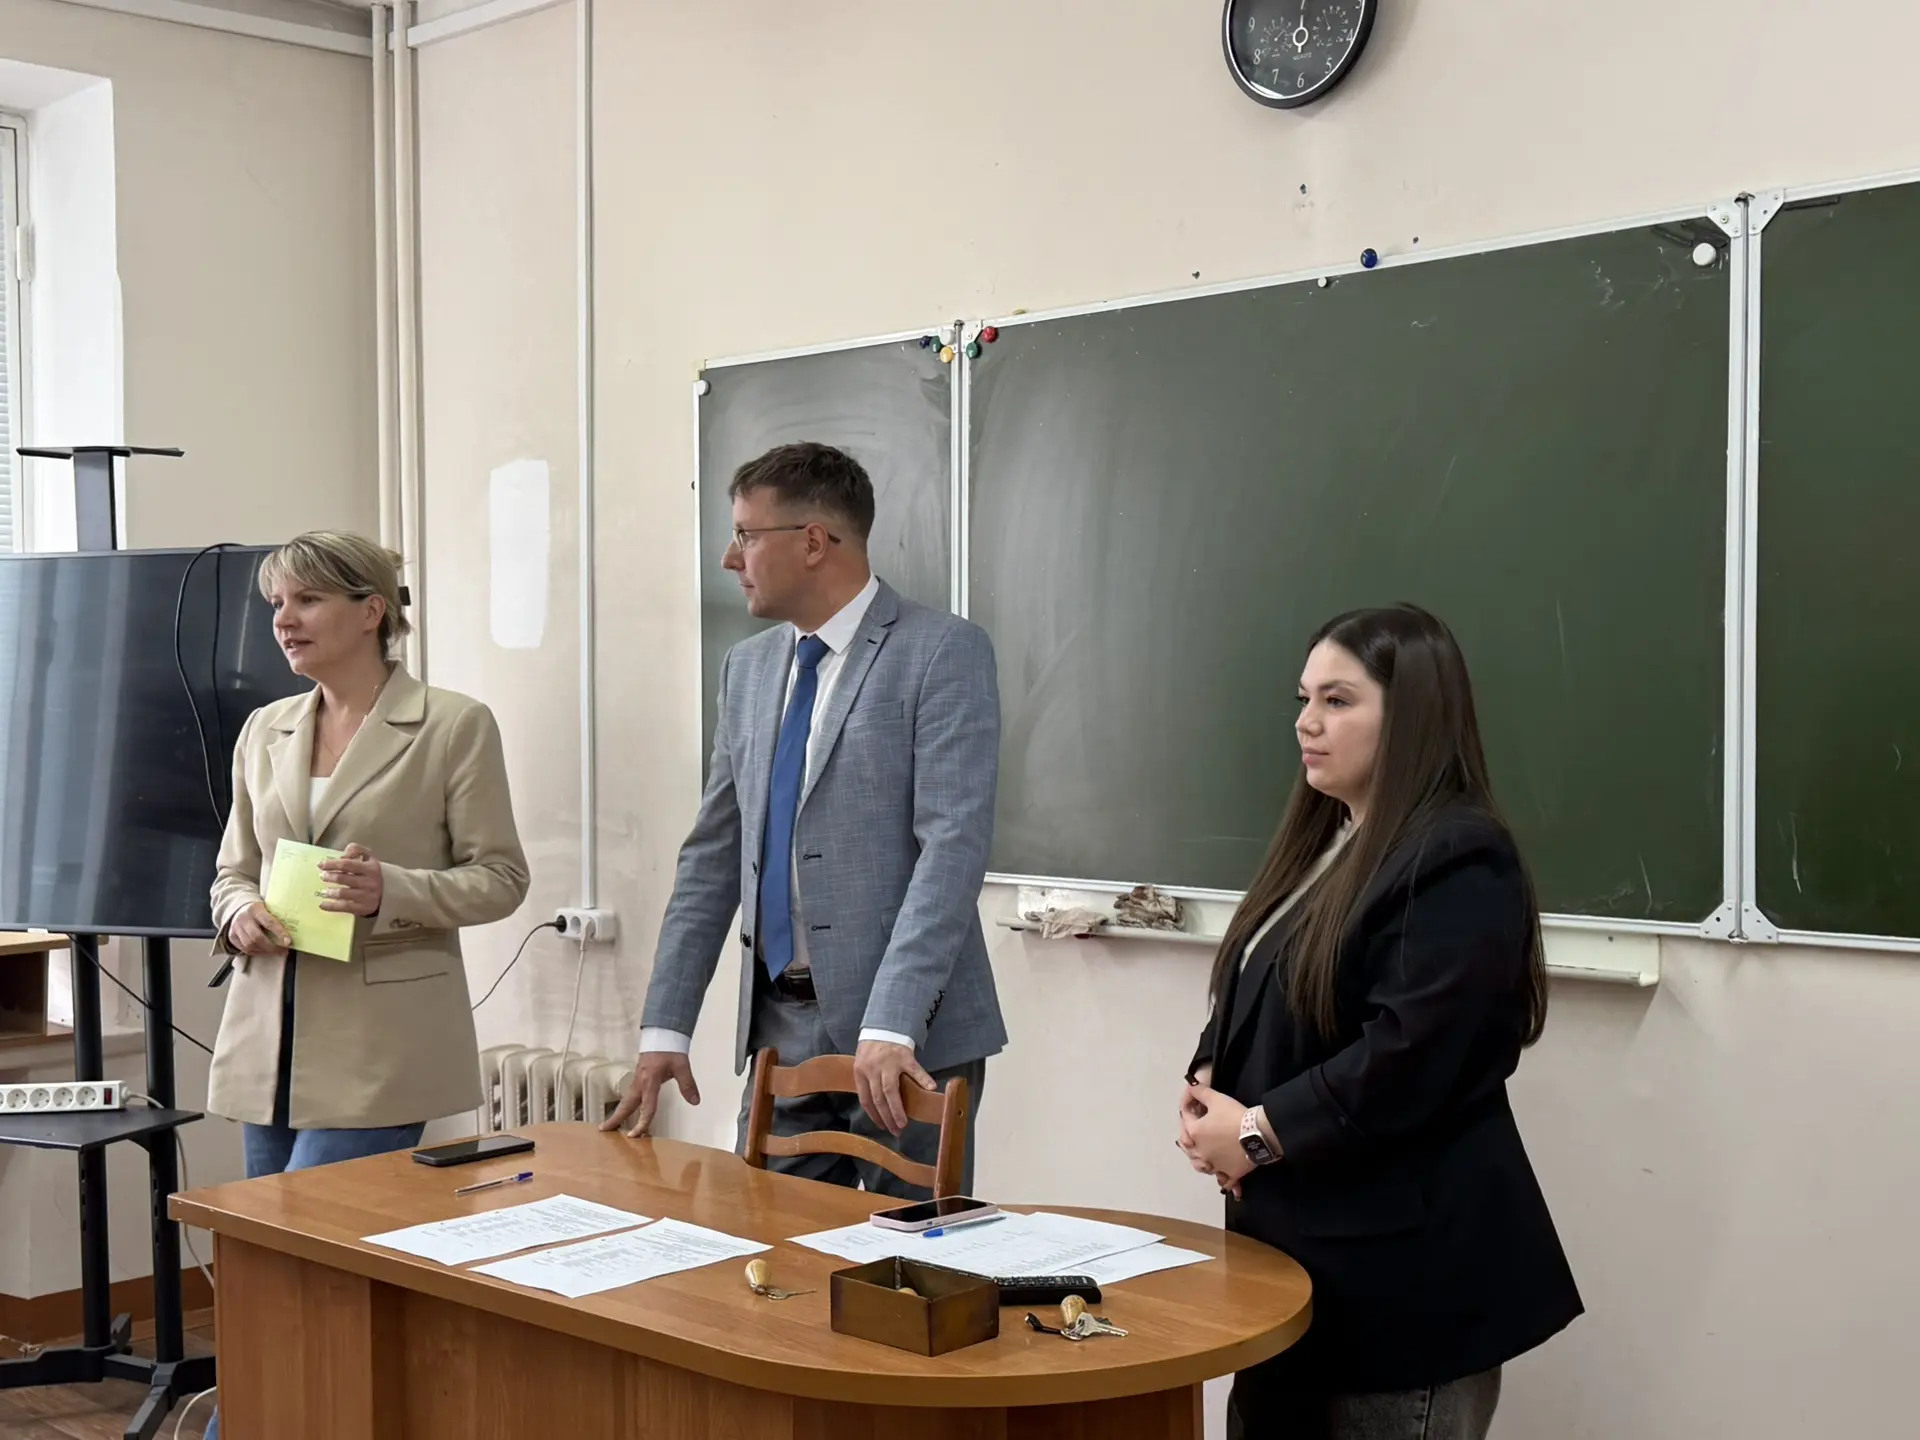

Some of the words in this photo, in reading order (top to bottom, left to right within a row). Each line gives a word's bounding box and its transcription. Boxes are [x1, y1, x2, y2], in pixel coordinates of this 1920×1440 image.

[1248, 16, 1255, 33] 9
[1346, 28, 1353, 41] 4
[1253, 48, 1261, 65] 8
[1324, 57, 1332, 74] 5
[1271, 68, 1279, 85] 7
[1296, 72, 1305, 88] 6
